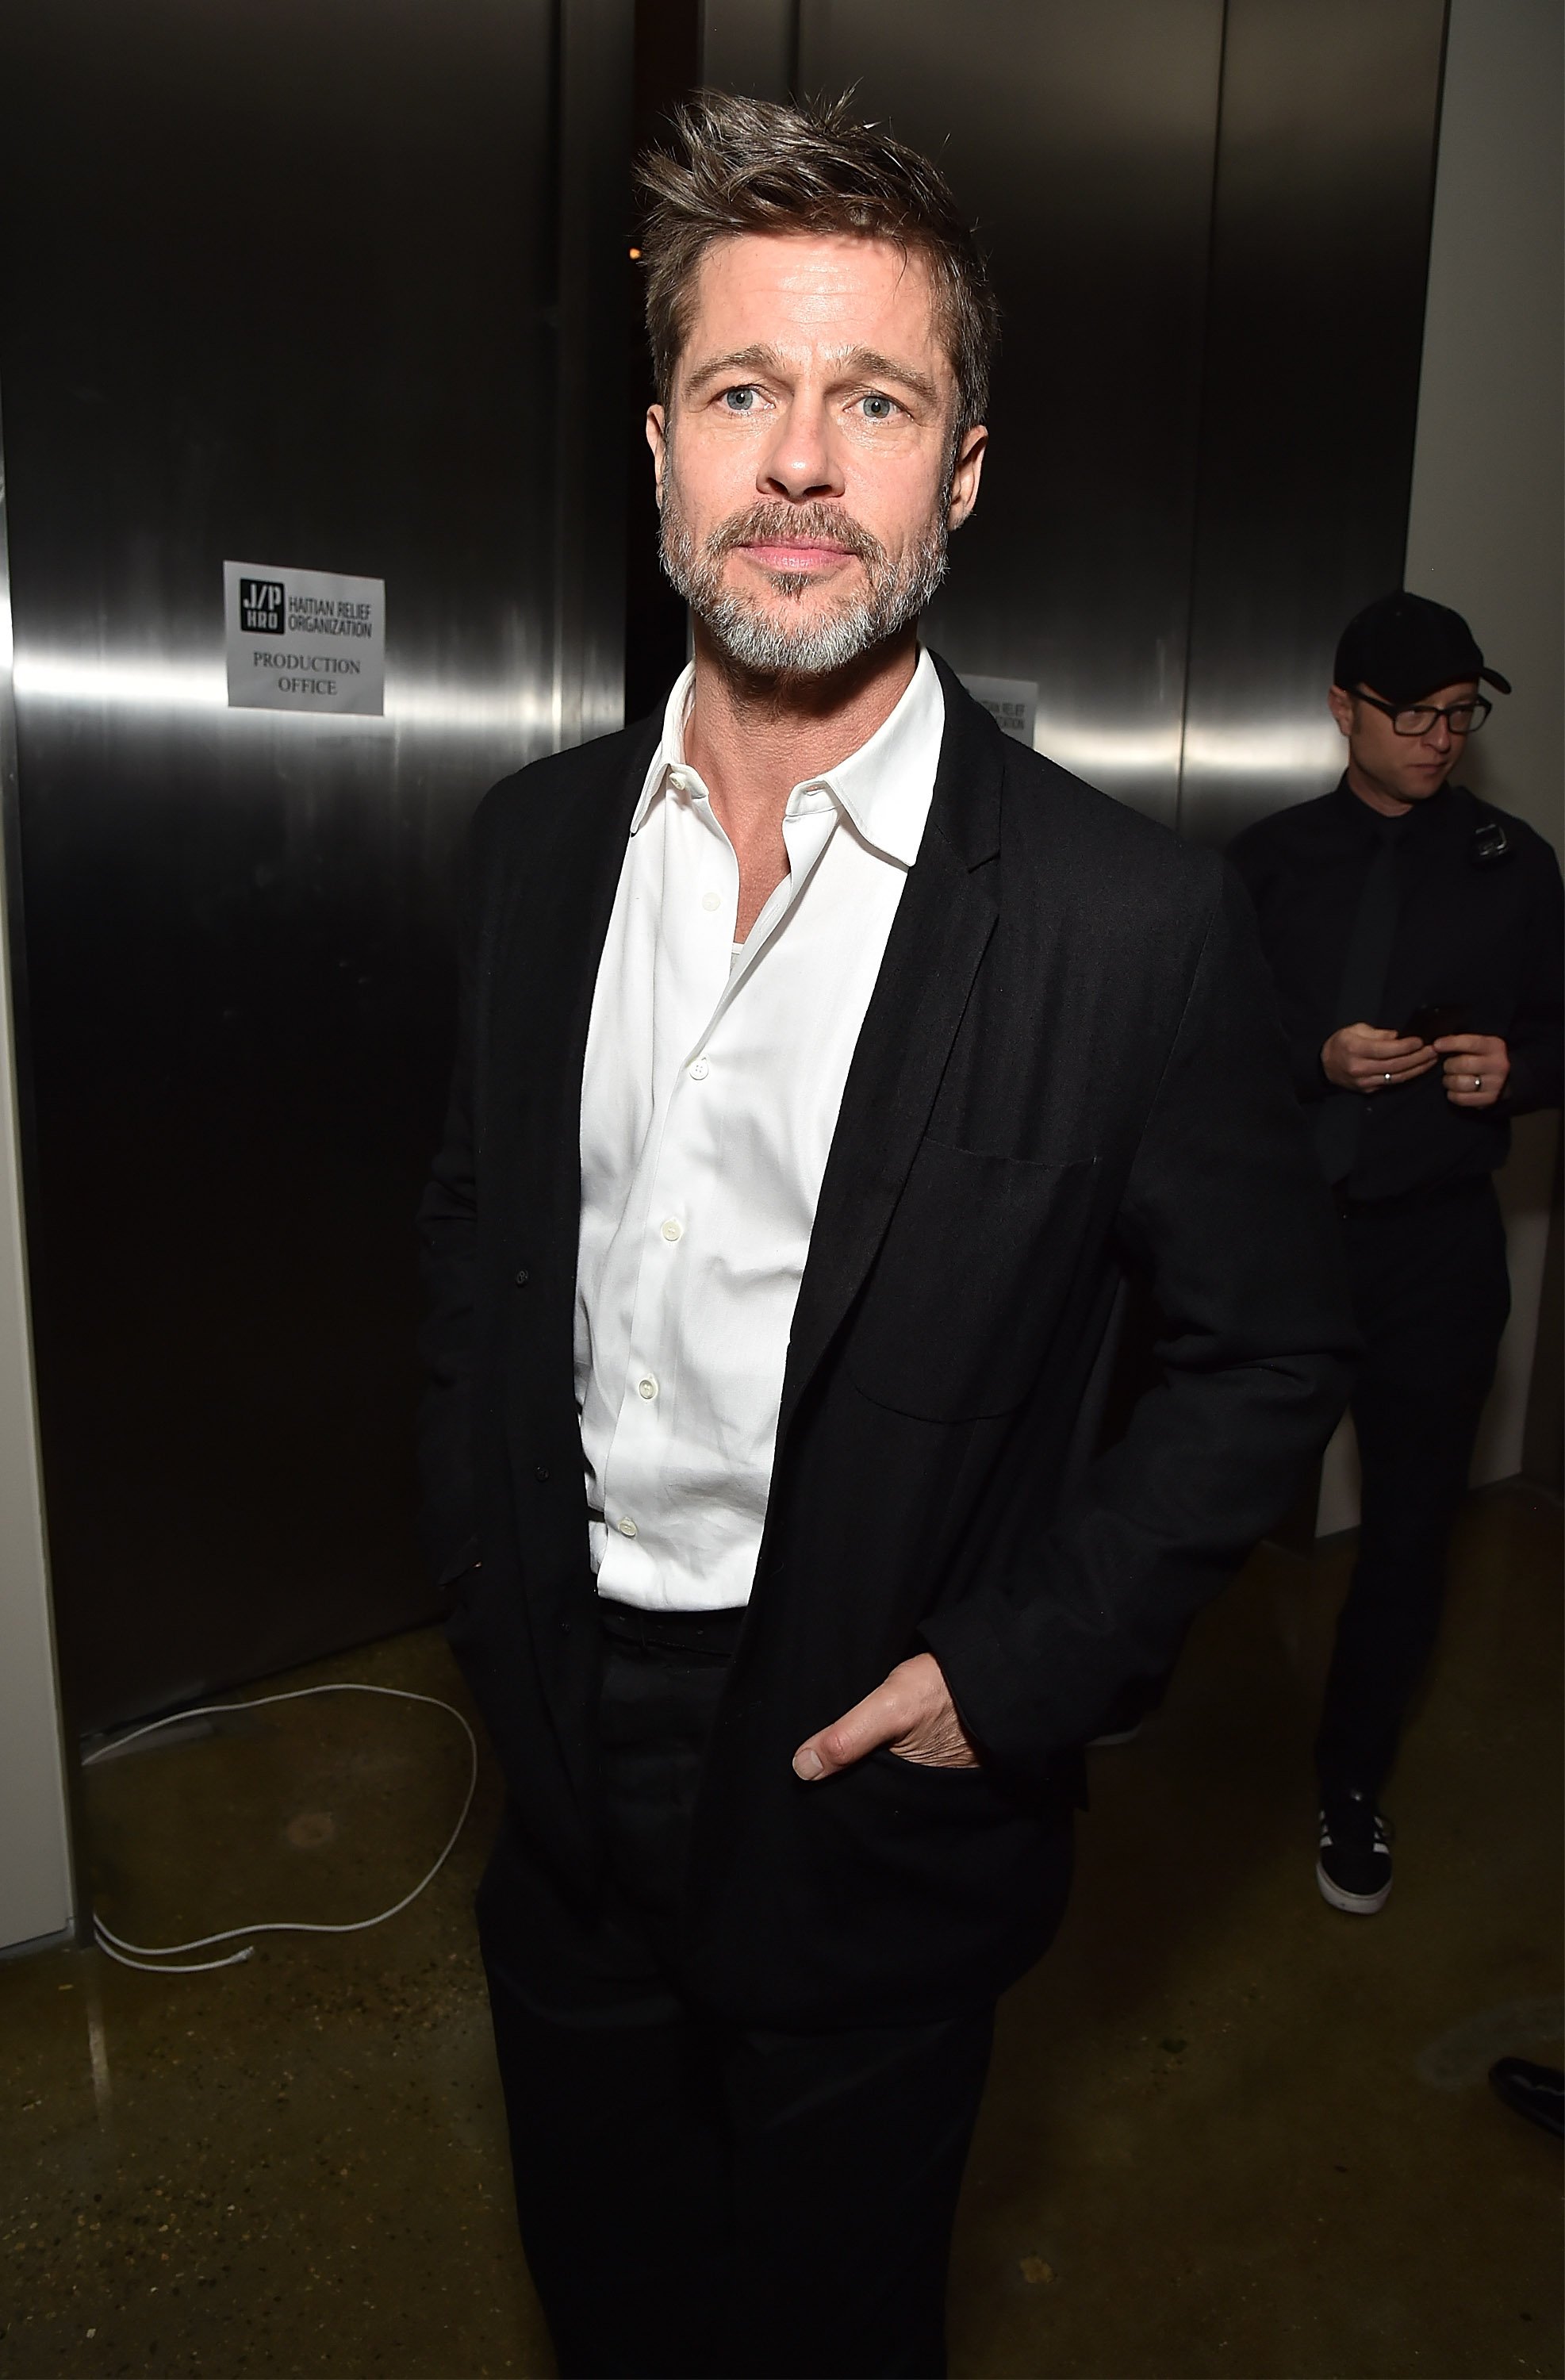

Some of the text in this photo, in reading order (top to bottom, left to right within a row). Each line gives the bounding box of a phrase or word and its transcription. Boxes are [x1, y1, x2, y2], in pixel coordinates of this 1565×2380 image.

[243, 583, 282, 610] J/P
[289, 596, 371, 619] HAITIAN RELIEF
[246, 610, 278, 630] HRO
[288, 615, 372, 639] ORGANIZATION
[253, 651, 361, 674] PRODUCTION
[278, 677, 338, 696] OFFICE
